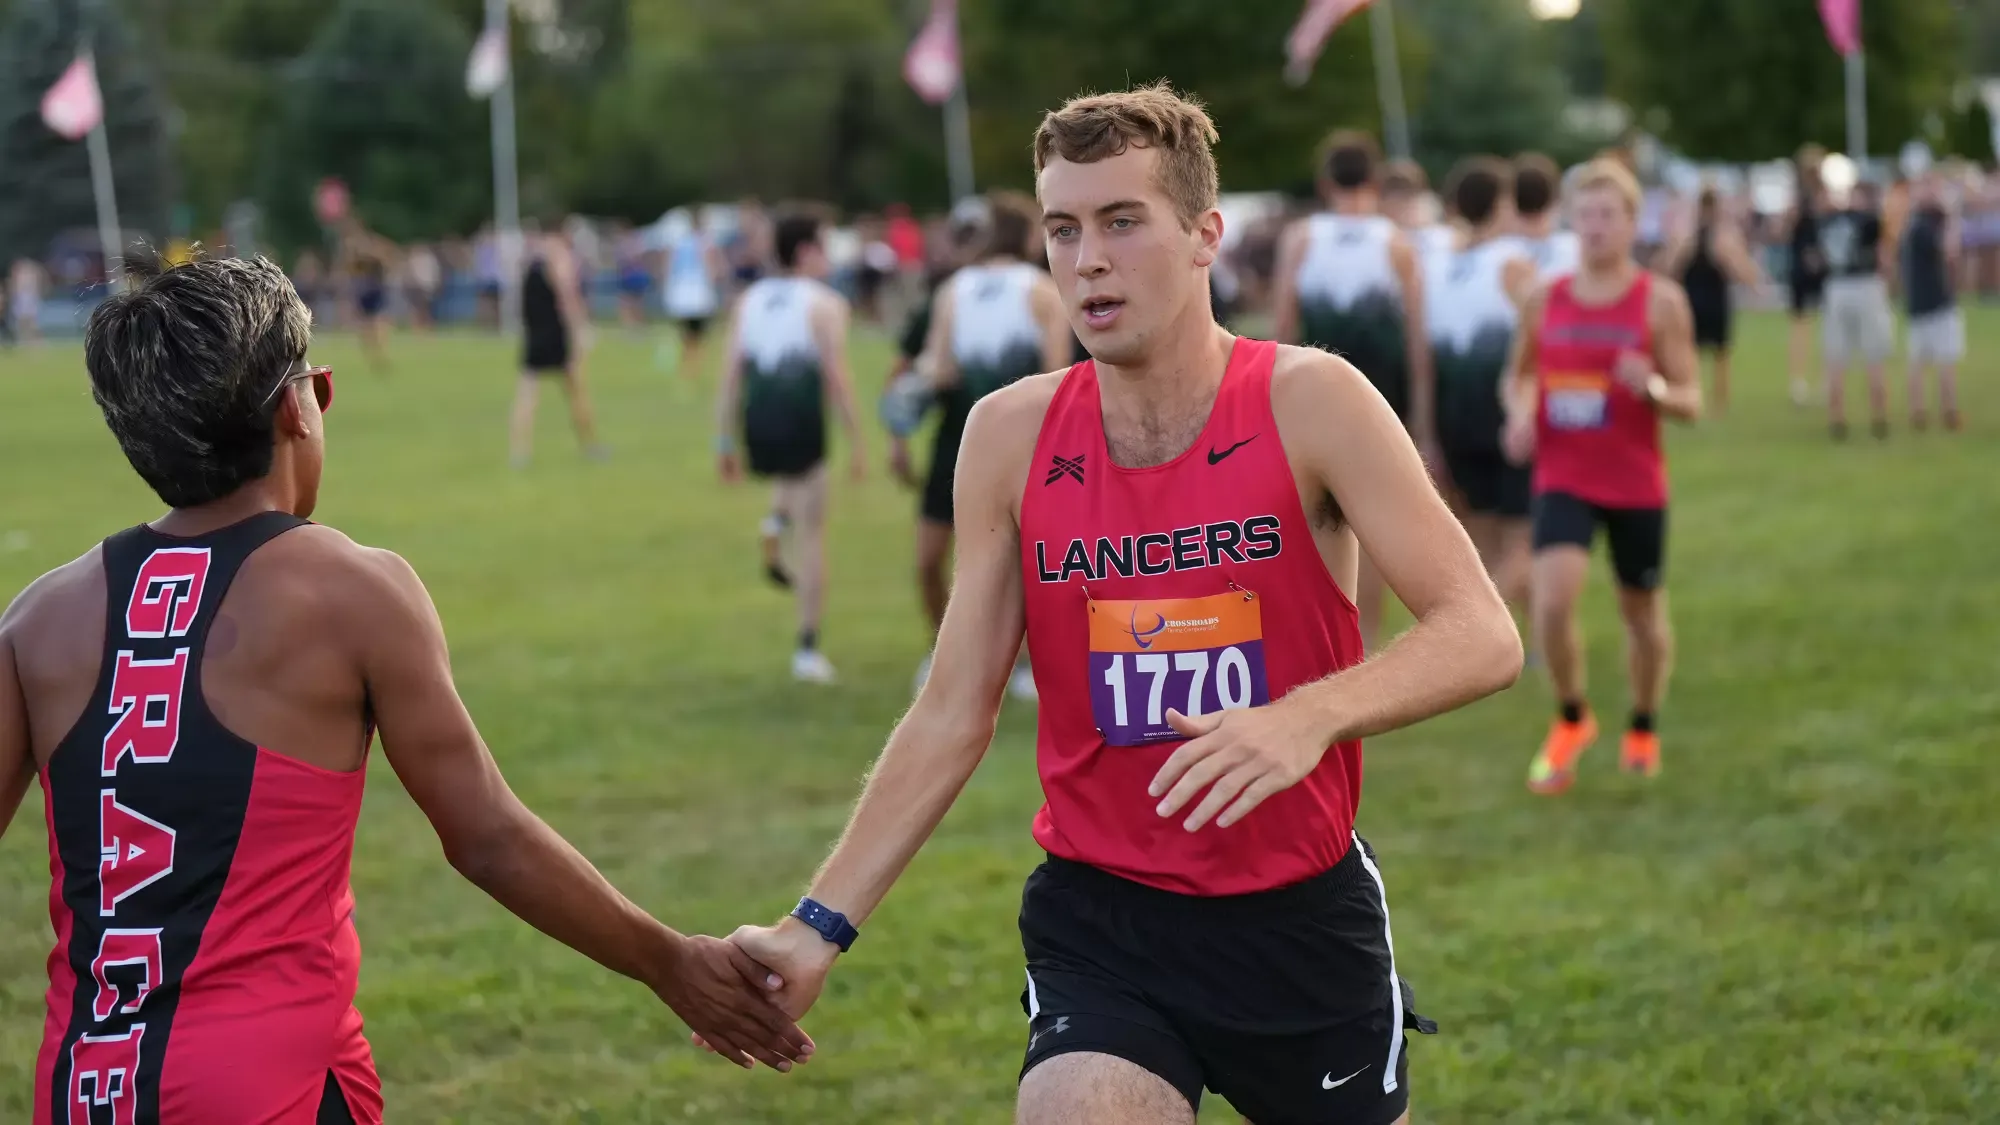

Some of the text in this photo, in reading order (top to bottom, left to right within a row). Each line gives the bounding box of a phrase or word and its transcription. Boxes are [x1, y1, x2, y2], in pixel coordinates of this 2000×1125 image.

[1035, 515, 1282, 583] LANCERS
[1164, 616, 1220, 628] CROSSROADS
[1104, 646, 1252, 726] 1770
[67, 546, 212, 1125] GRACE
